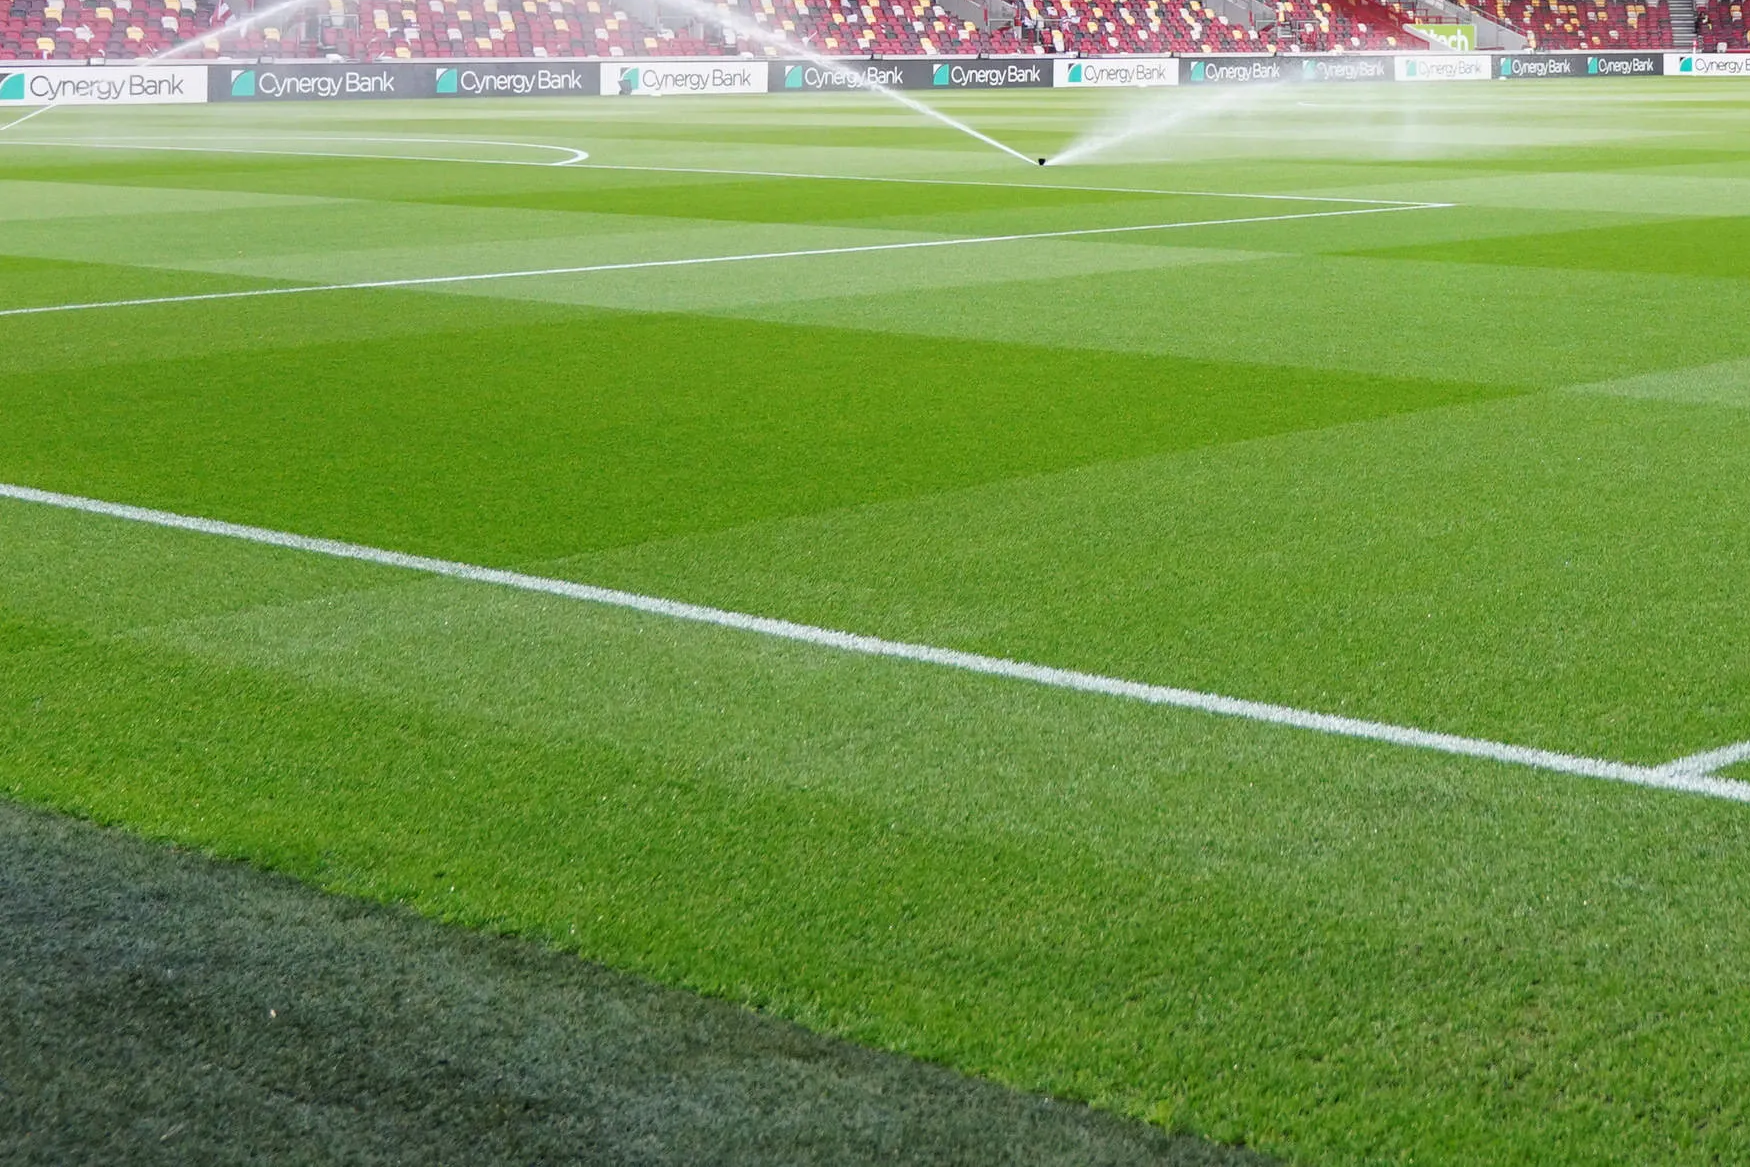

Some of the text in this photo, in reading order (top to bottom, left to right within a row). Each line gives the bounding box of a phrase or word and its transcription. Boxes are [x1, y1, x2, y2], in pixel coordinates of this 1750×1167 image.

[951, 64, 1041, 87] Cynergy Bank
[1083, 63, 1166, 84] Cynergy Bank
[1204, 62, 1280, 82] Cynergy Bank
[1317, 61, 1385, 81] Cynergy Bank
[1418, 60, 1482, 78] Cynergy Bank
[1511, 59, 1571, 76] Cynergy Bank
[1598, 57, 1654, 75] Cynergy Bank
[1695, 57, 1743, 74] Cynergy
[30, 73, 184, 101] Cynergy Bank
[258, 70, 395, 99] Cynergy Bank
[460, 70, 582, 94] Cynergy Bank
[642, 68, 751, 91] Cynergy Bank
[804, 66, 904, 89] Cynergy Bank
